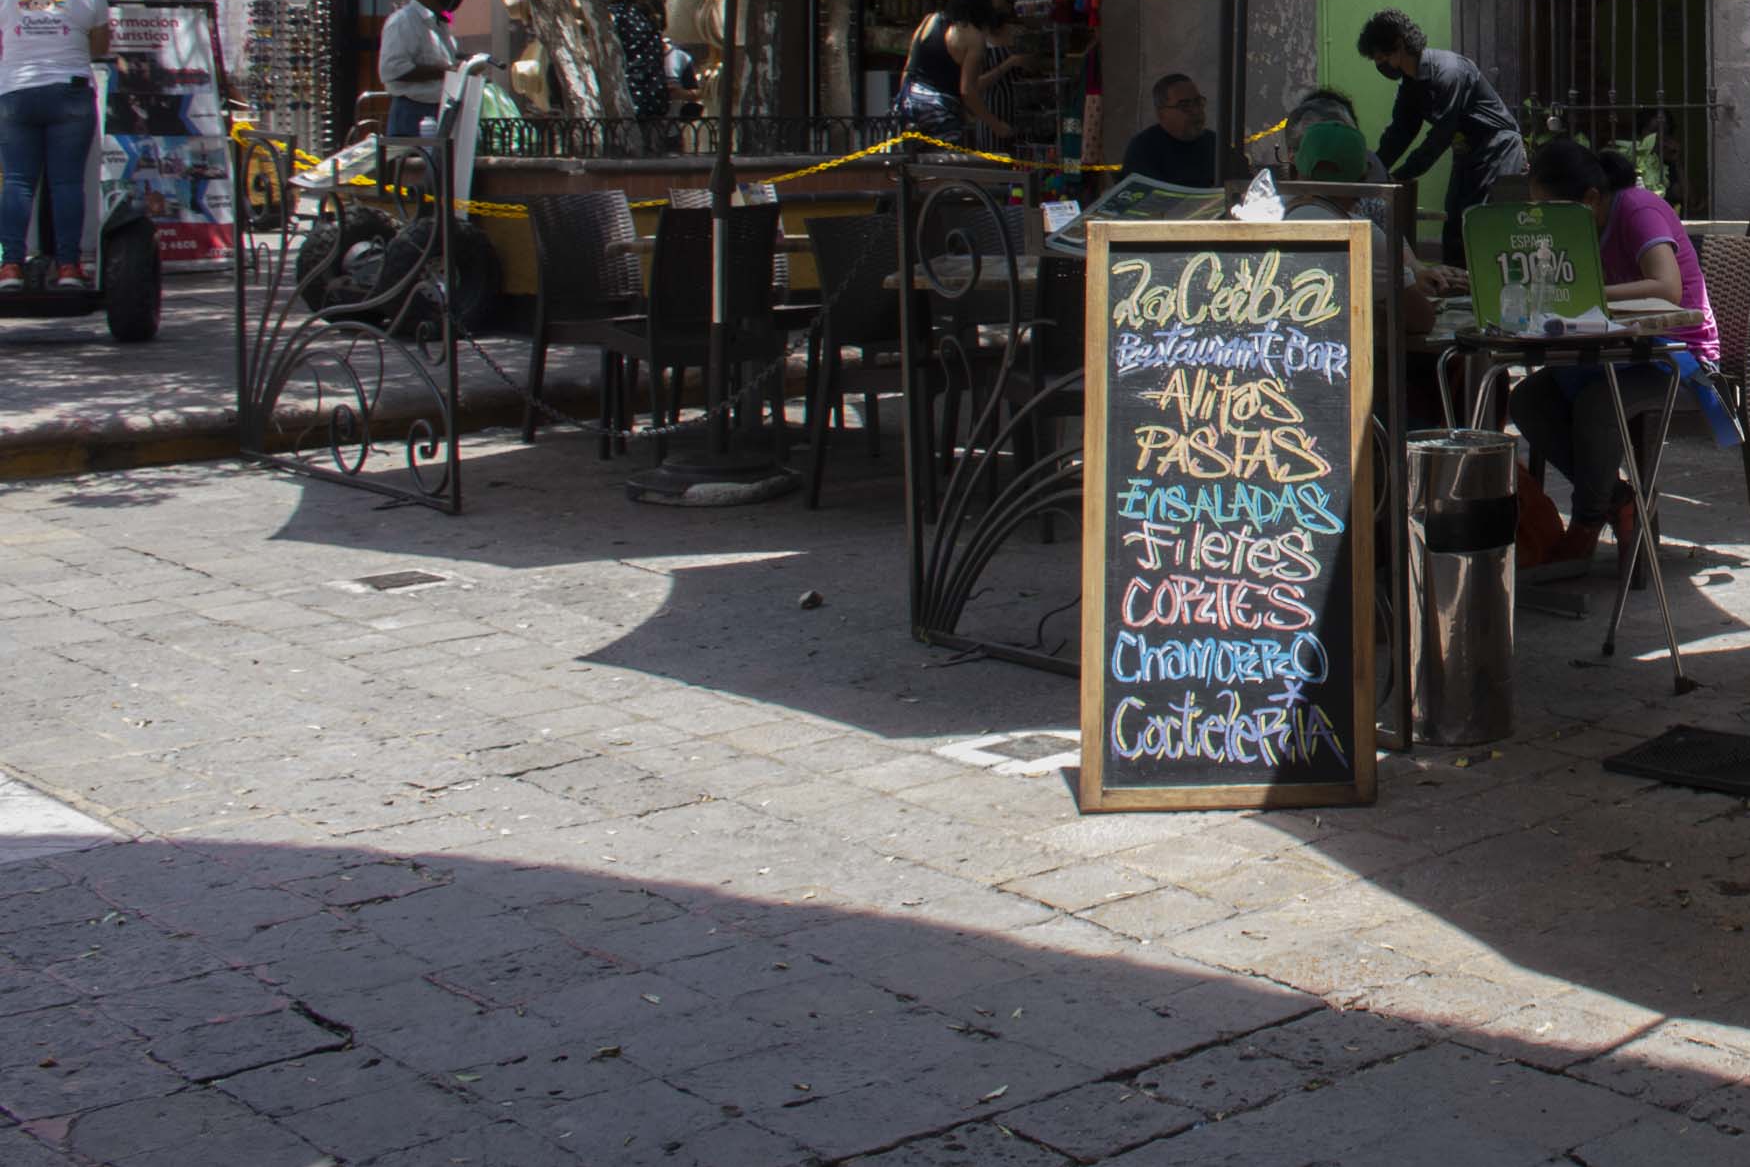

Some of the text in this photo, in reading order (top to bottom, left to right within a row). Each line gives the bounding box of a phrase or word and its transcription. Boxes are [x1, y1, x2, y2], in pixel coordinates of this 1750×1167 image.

[1176, 250, 1341, 328] Ceiba
[1134, 424, 1332, 482] PASTAS
[1121, 574, 1317, 631] CORTES
